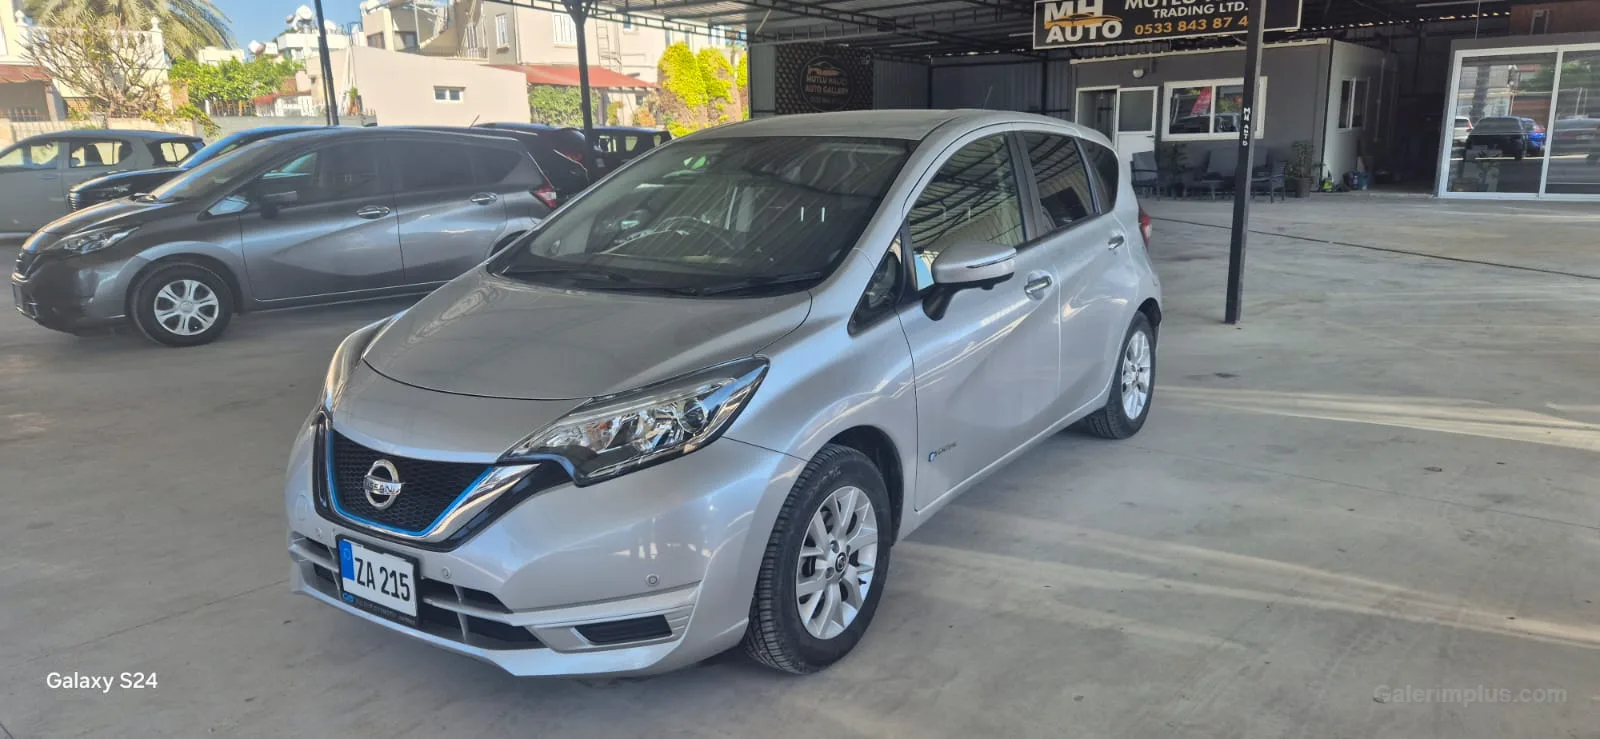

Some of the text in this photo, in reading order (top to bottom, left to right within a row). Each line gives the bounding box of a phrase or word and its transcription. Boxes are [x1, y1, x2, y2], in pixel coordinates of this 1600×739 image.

[1044, 0, 1104, 24] MH
[1153, 2, 1248, 19] TRADING LTD.
[1045, 20, 1123, 43] AUTO
[1134, 22, 1173, 36] 0533
[1177, 19, 1207, 32] 843
[1212, 17, 1233, 29] 87
[355, 557, 411, 602] ZA 215
